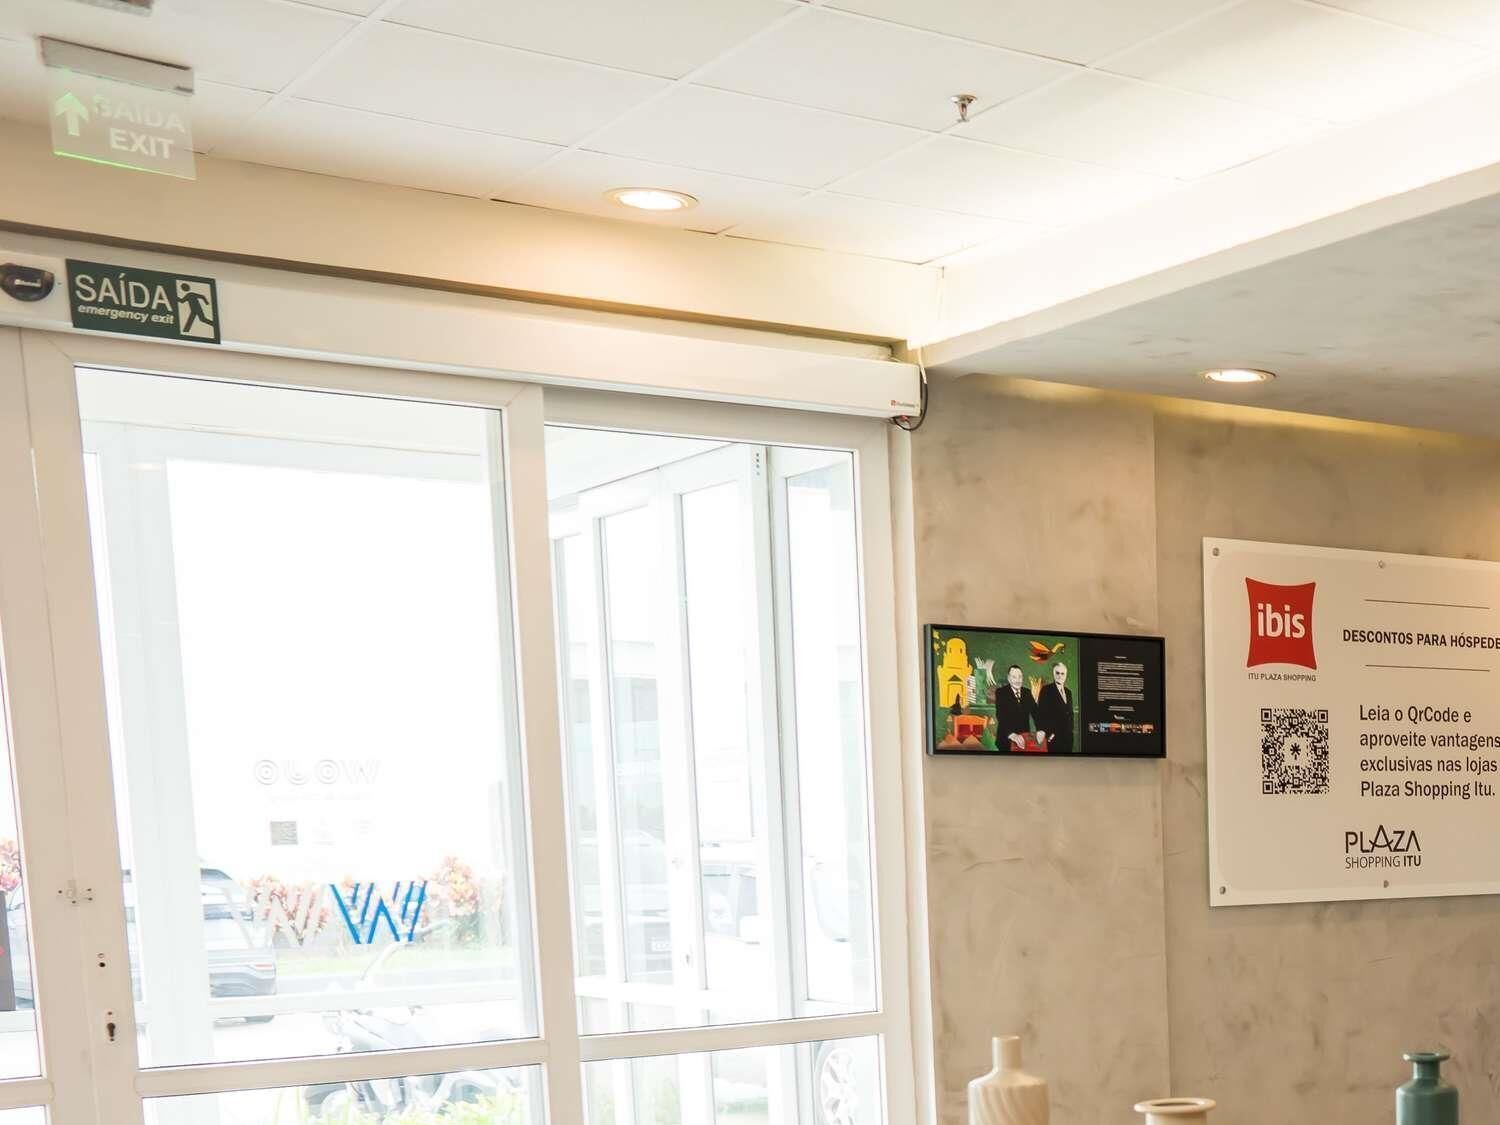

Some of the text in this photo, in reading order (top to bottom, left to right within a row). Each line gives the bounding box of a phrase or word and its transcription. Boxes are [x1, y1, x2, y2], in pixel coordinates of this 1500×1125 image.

[109, 128, 174, 159] EXIT
[75, 273, 173, 312] SAÍDA
[78, 305, 174, 324] emergency exit
[1257, 602, 1306, 638] ibis
[1343, 629, 1413, 645] DESCONTOS
[1417, 633, 1447, 647] PARA
[1248, 672, 1259, 680] ITU
[1284, 673, 1316, 681] SHOPPING
[1359, 705, 1472, 725] Leia o QrCode e
[1360, 732, 1500, 751] aproveite vantagens
[1360, 756, 1432, 772] exclusivas
[1437, 760, 1462, 772] nas
[1466, 757, 1498, 776] lojas
[1361, 781, 1495, 799] Plaza Shopping Itu.
[1345, 824, 1421, 854] PLAZA
[1345, 855, 1422, 869] SHOPPING ITU
